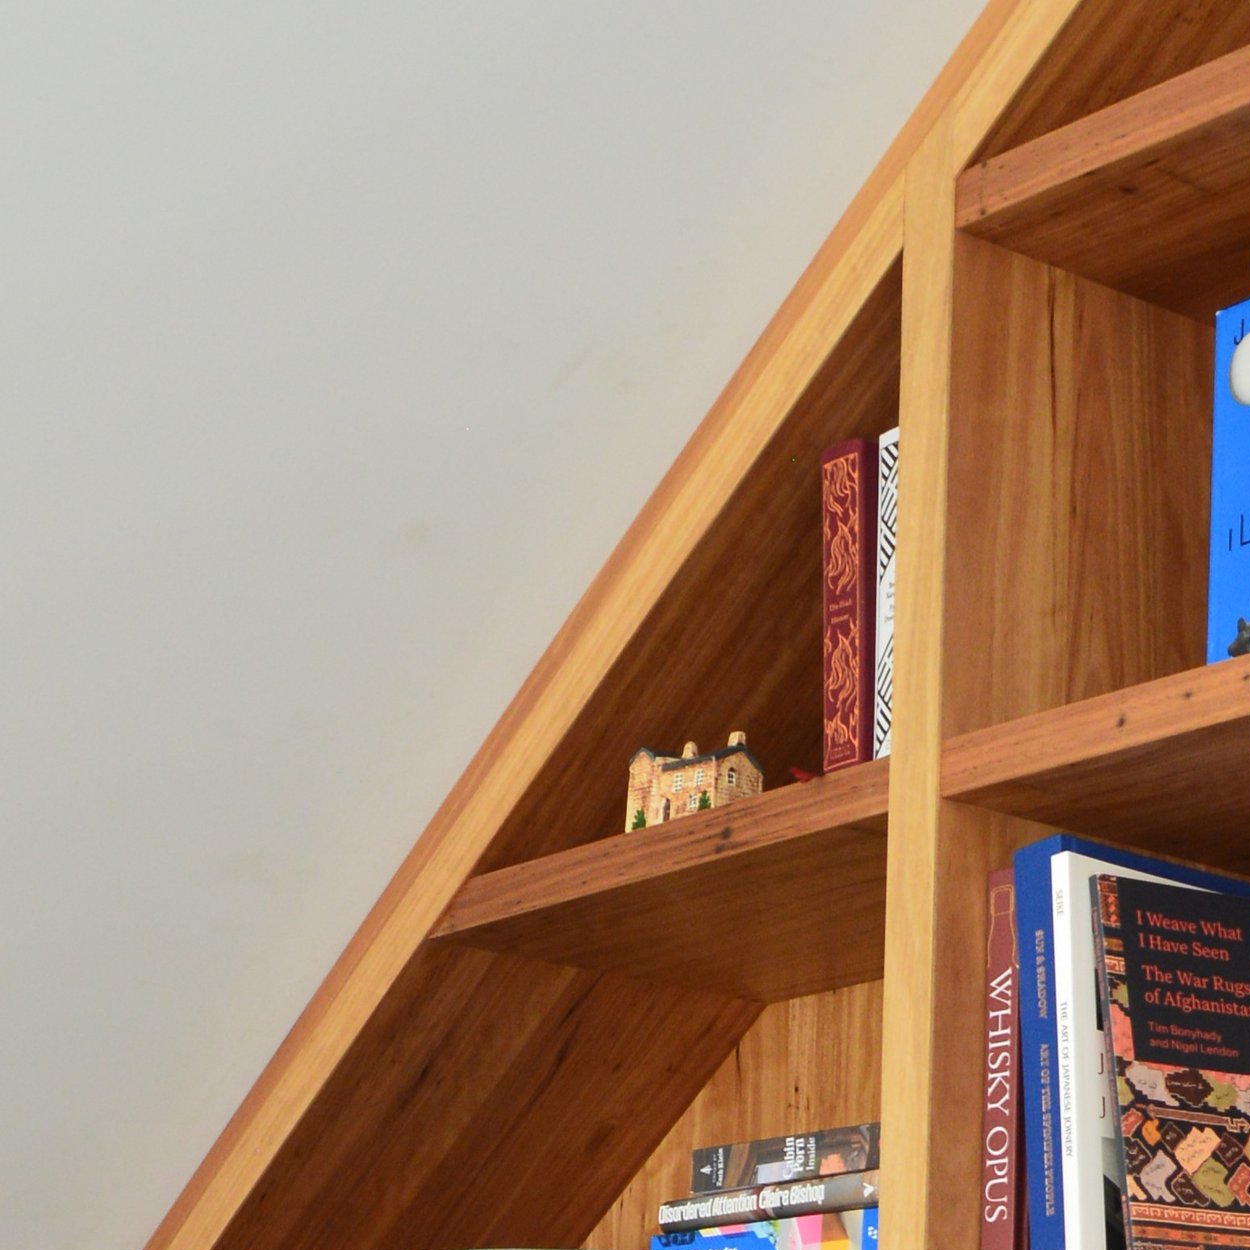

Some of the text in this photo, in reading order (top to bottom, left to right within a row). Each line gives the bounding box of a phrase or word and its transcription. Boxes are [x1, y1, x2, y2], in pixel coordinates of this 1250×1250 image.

[1054, 889, 1064, 917] SEIKE
[1136, 910, 1244, 941] I Weave What
[1138, 933, 1230, 961] I Have Seen
[1141, 964, 1173, 984] The
[1177, 970, 1209, 989] War
[1144, 988, 1161, 1004] of
[1148, 1021, 1222, 1043] Tim Bonyhady
[1150, 1038, 1240, 1058] and Nigel Lendon
[984, 966, 1012, 1224] WHISKY OPUS
[1060, 1001, 1074, 1158] THE ART OF JAPANESE JOINERY
[783, 1136, 795, 1179] Cabin
[794, 1137, 805, 1172] Porn
[806, 1136, 816, 1171] Inside
[658, 1183, 825, 1224] Disordered Attention Claire Bishop
